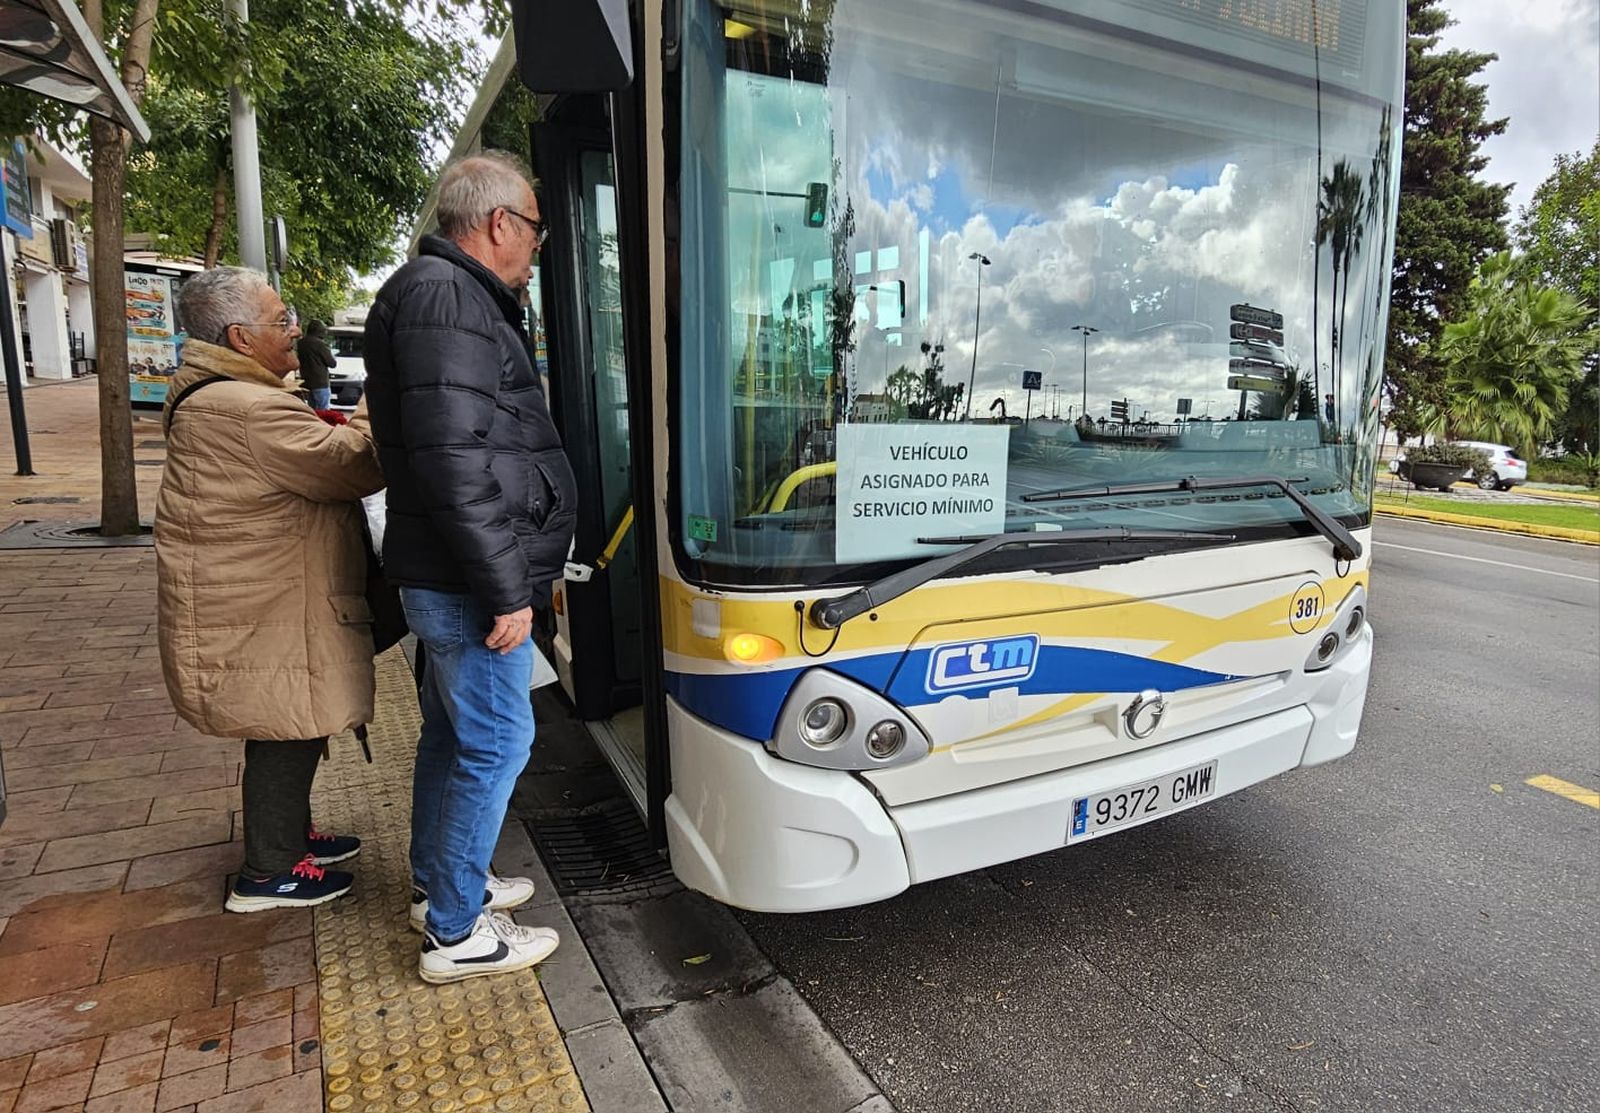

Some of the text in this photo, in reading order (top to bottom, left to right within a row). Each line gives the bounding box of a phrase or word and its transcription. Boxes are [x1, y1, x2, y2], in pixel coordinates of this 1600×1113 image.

[890, 442, 968, 461] VEHÍCULO
[860, 472, 989, 489] ASIGNADO PARA
[853, 497, 993, 518] SERVICIO MÍNIMO
[1296, 596, 1319, 619] 381
[1095, 766, 1212, 825] 9372 GMW
